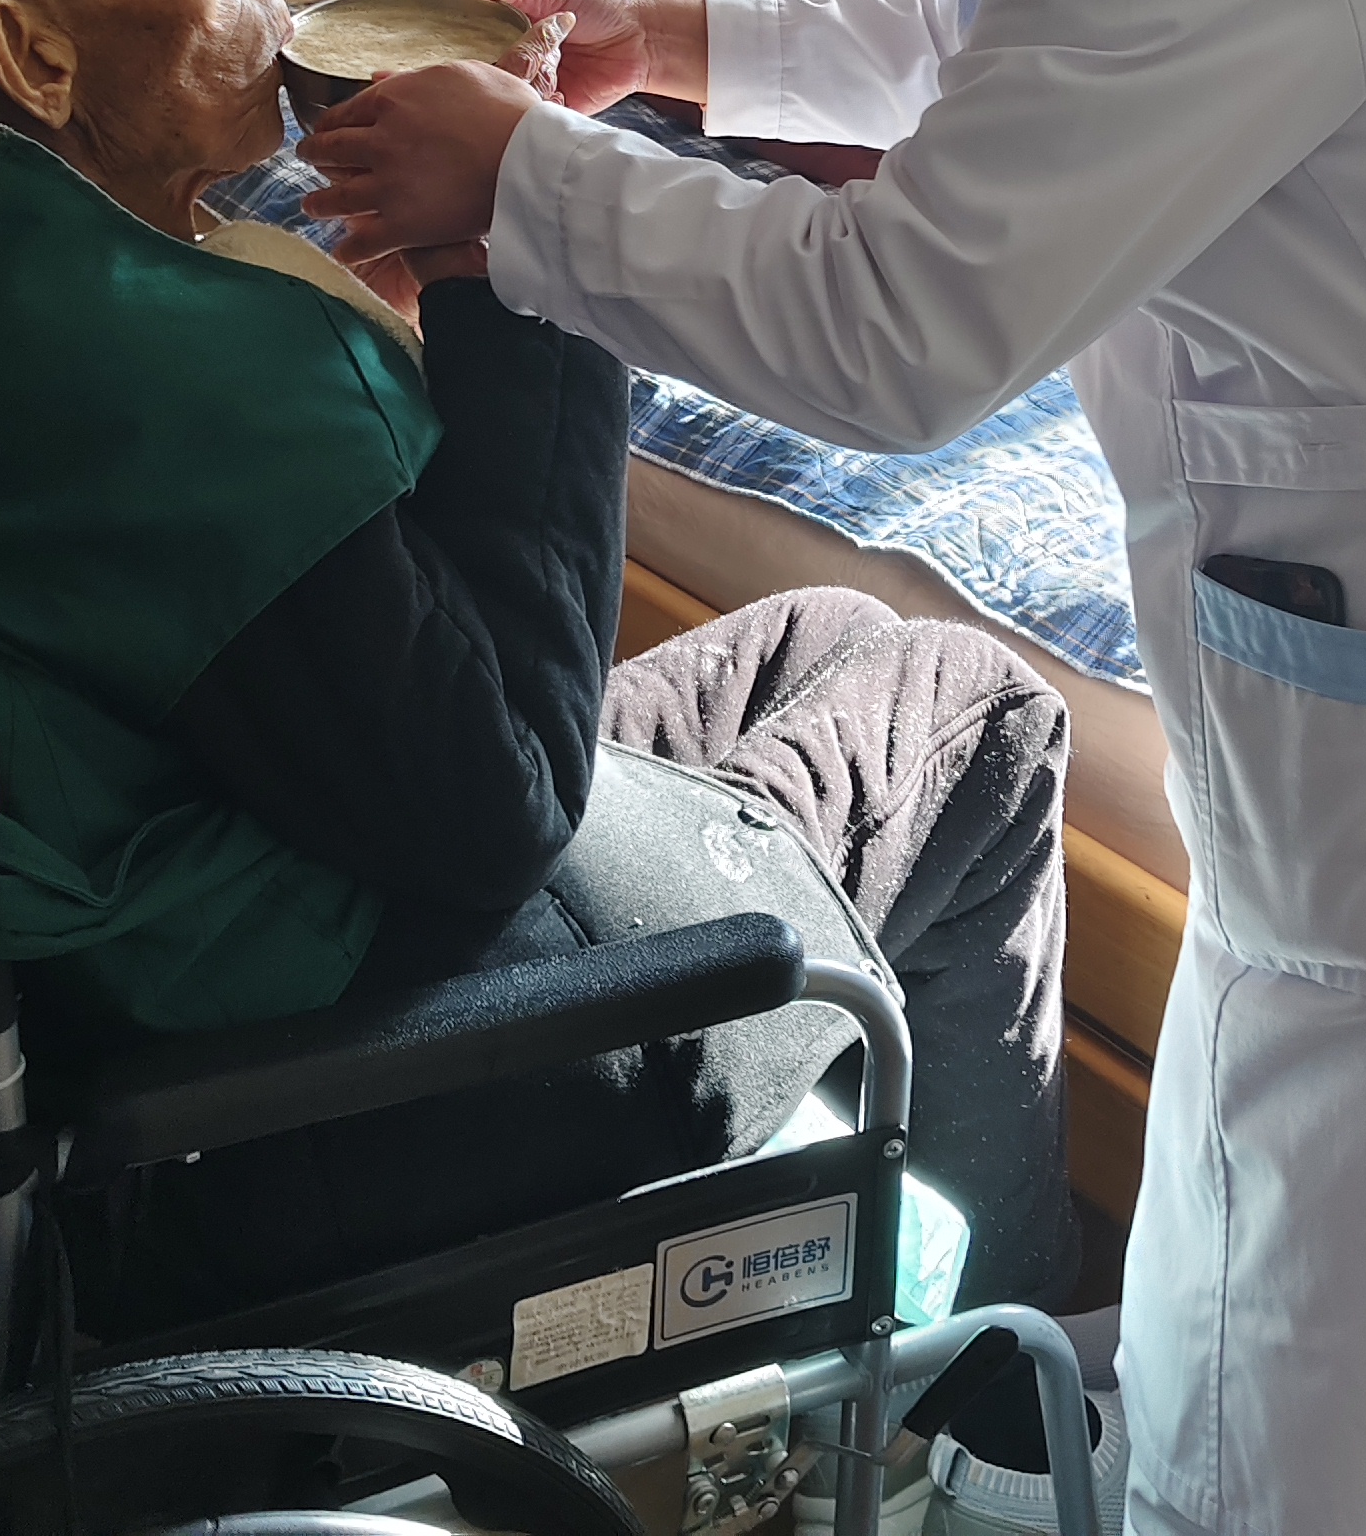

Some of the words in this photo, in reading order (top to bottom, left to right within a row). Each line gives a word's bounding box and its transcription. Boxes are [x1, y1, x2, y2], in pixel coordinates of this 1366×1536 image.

[742, 1236, 831, 1279] 恒倍舒
[741, 1264, 830, 1293] HEABENS
